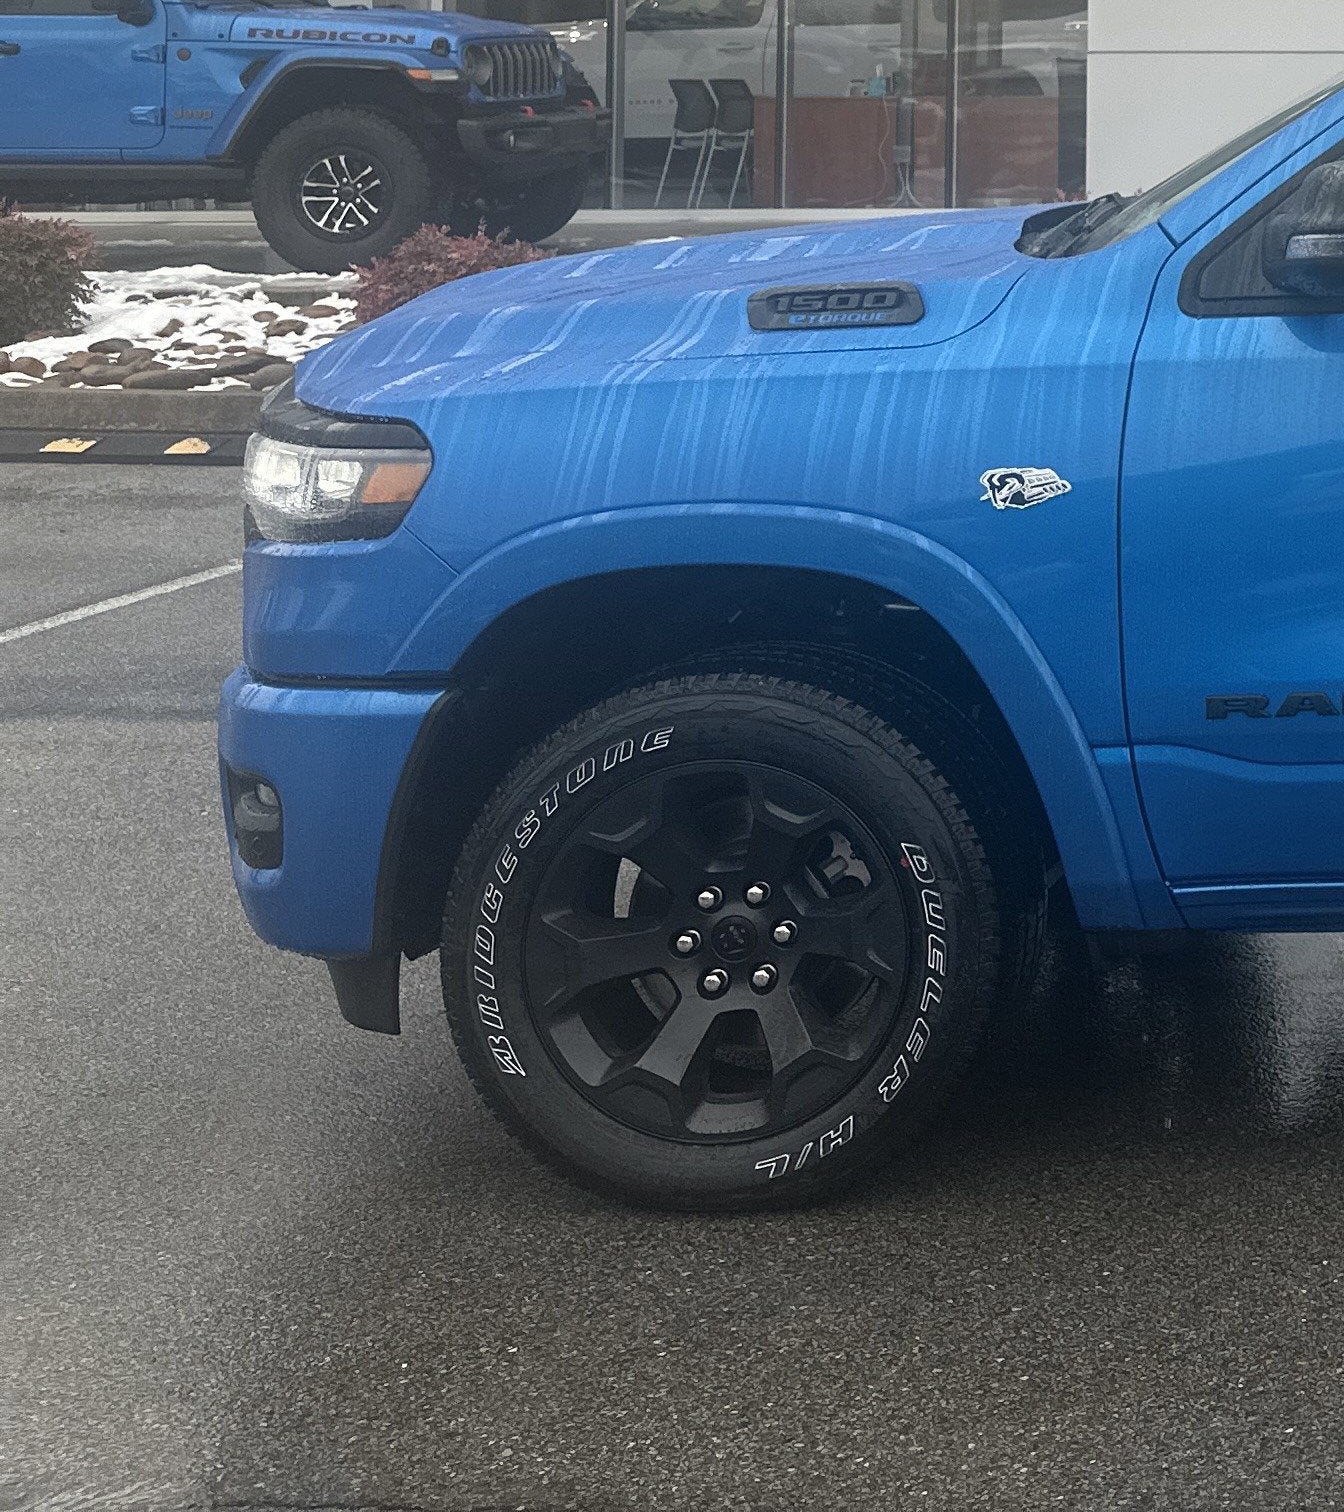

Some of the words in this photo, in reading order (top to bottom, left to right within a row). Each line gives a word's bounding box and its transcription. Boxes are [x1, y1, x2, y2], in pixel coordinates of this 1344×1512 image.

[247, 27, 416, 45] RUBICON
[776, 292, 898, 311] 1500
[473, 725, 674, 1077] BRIDGESTONE
[878, 841, 949, 1104] DUELER
[754, 1114, 854, 1180] H/L
